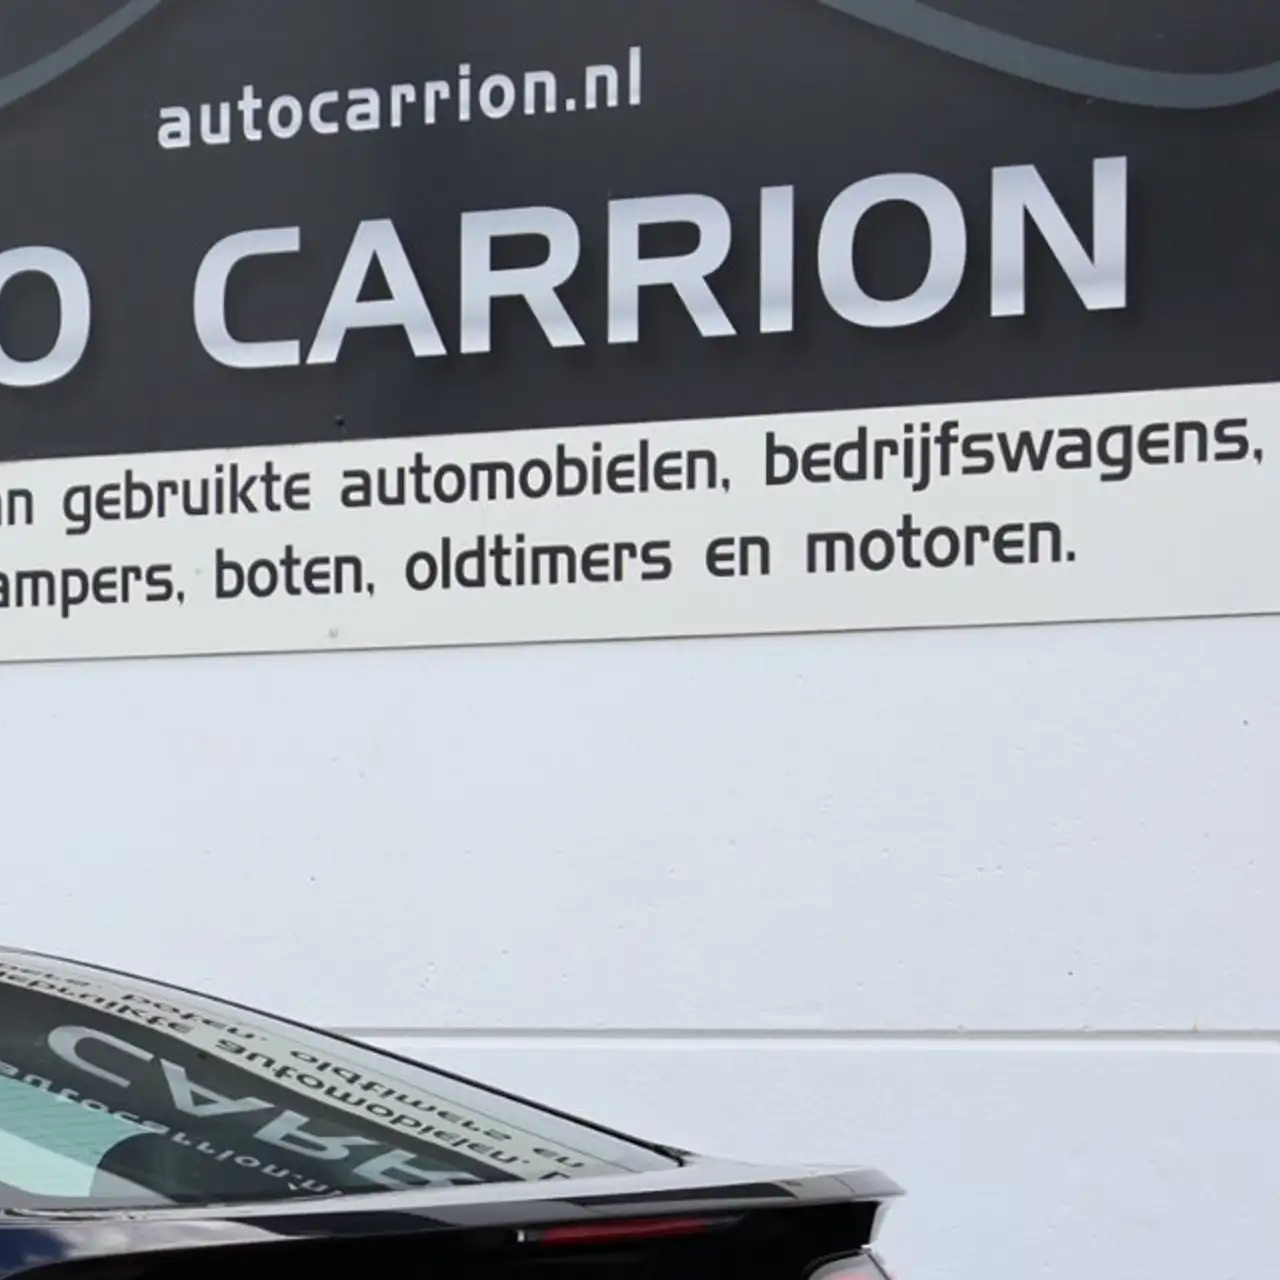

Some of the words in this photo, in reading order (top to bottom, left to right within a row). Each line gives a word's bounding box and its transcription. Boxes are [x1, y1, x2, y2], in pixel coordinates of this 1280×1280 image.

[157, 46, 641, 149] autocarrion.nl
[193, 156, 1128, 368] CARRION
[63, 461, 310, 536] gebruikte
[341, 439, 730, 508] automobielen,
[765, 418, 1263, 492] bedrijfswagens,
[215, 544, 375, 599] boten,
[405, 533, 672, 591] oldtimers
[705, 536, 770, 577] en
[807, 513, 1076, 574] motoren.
